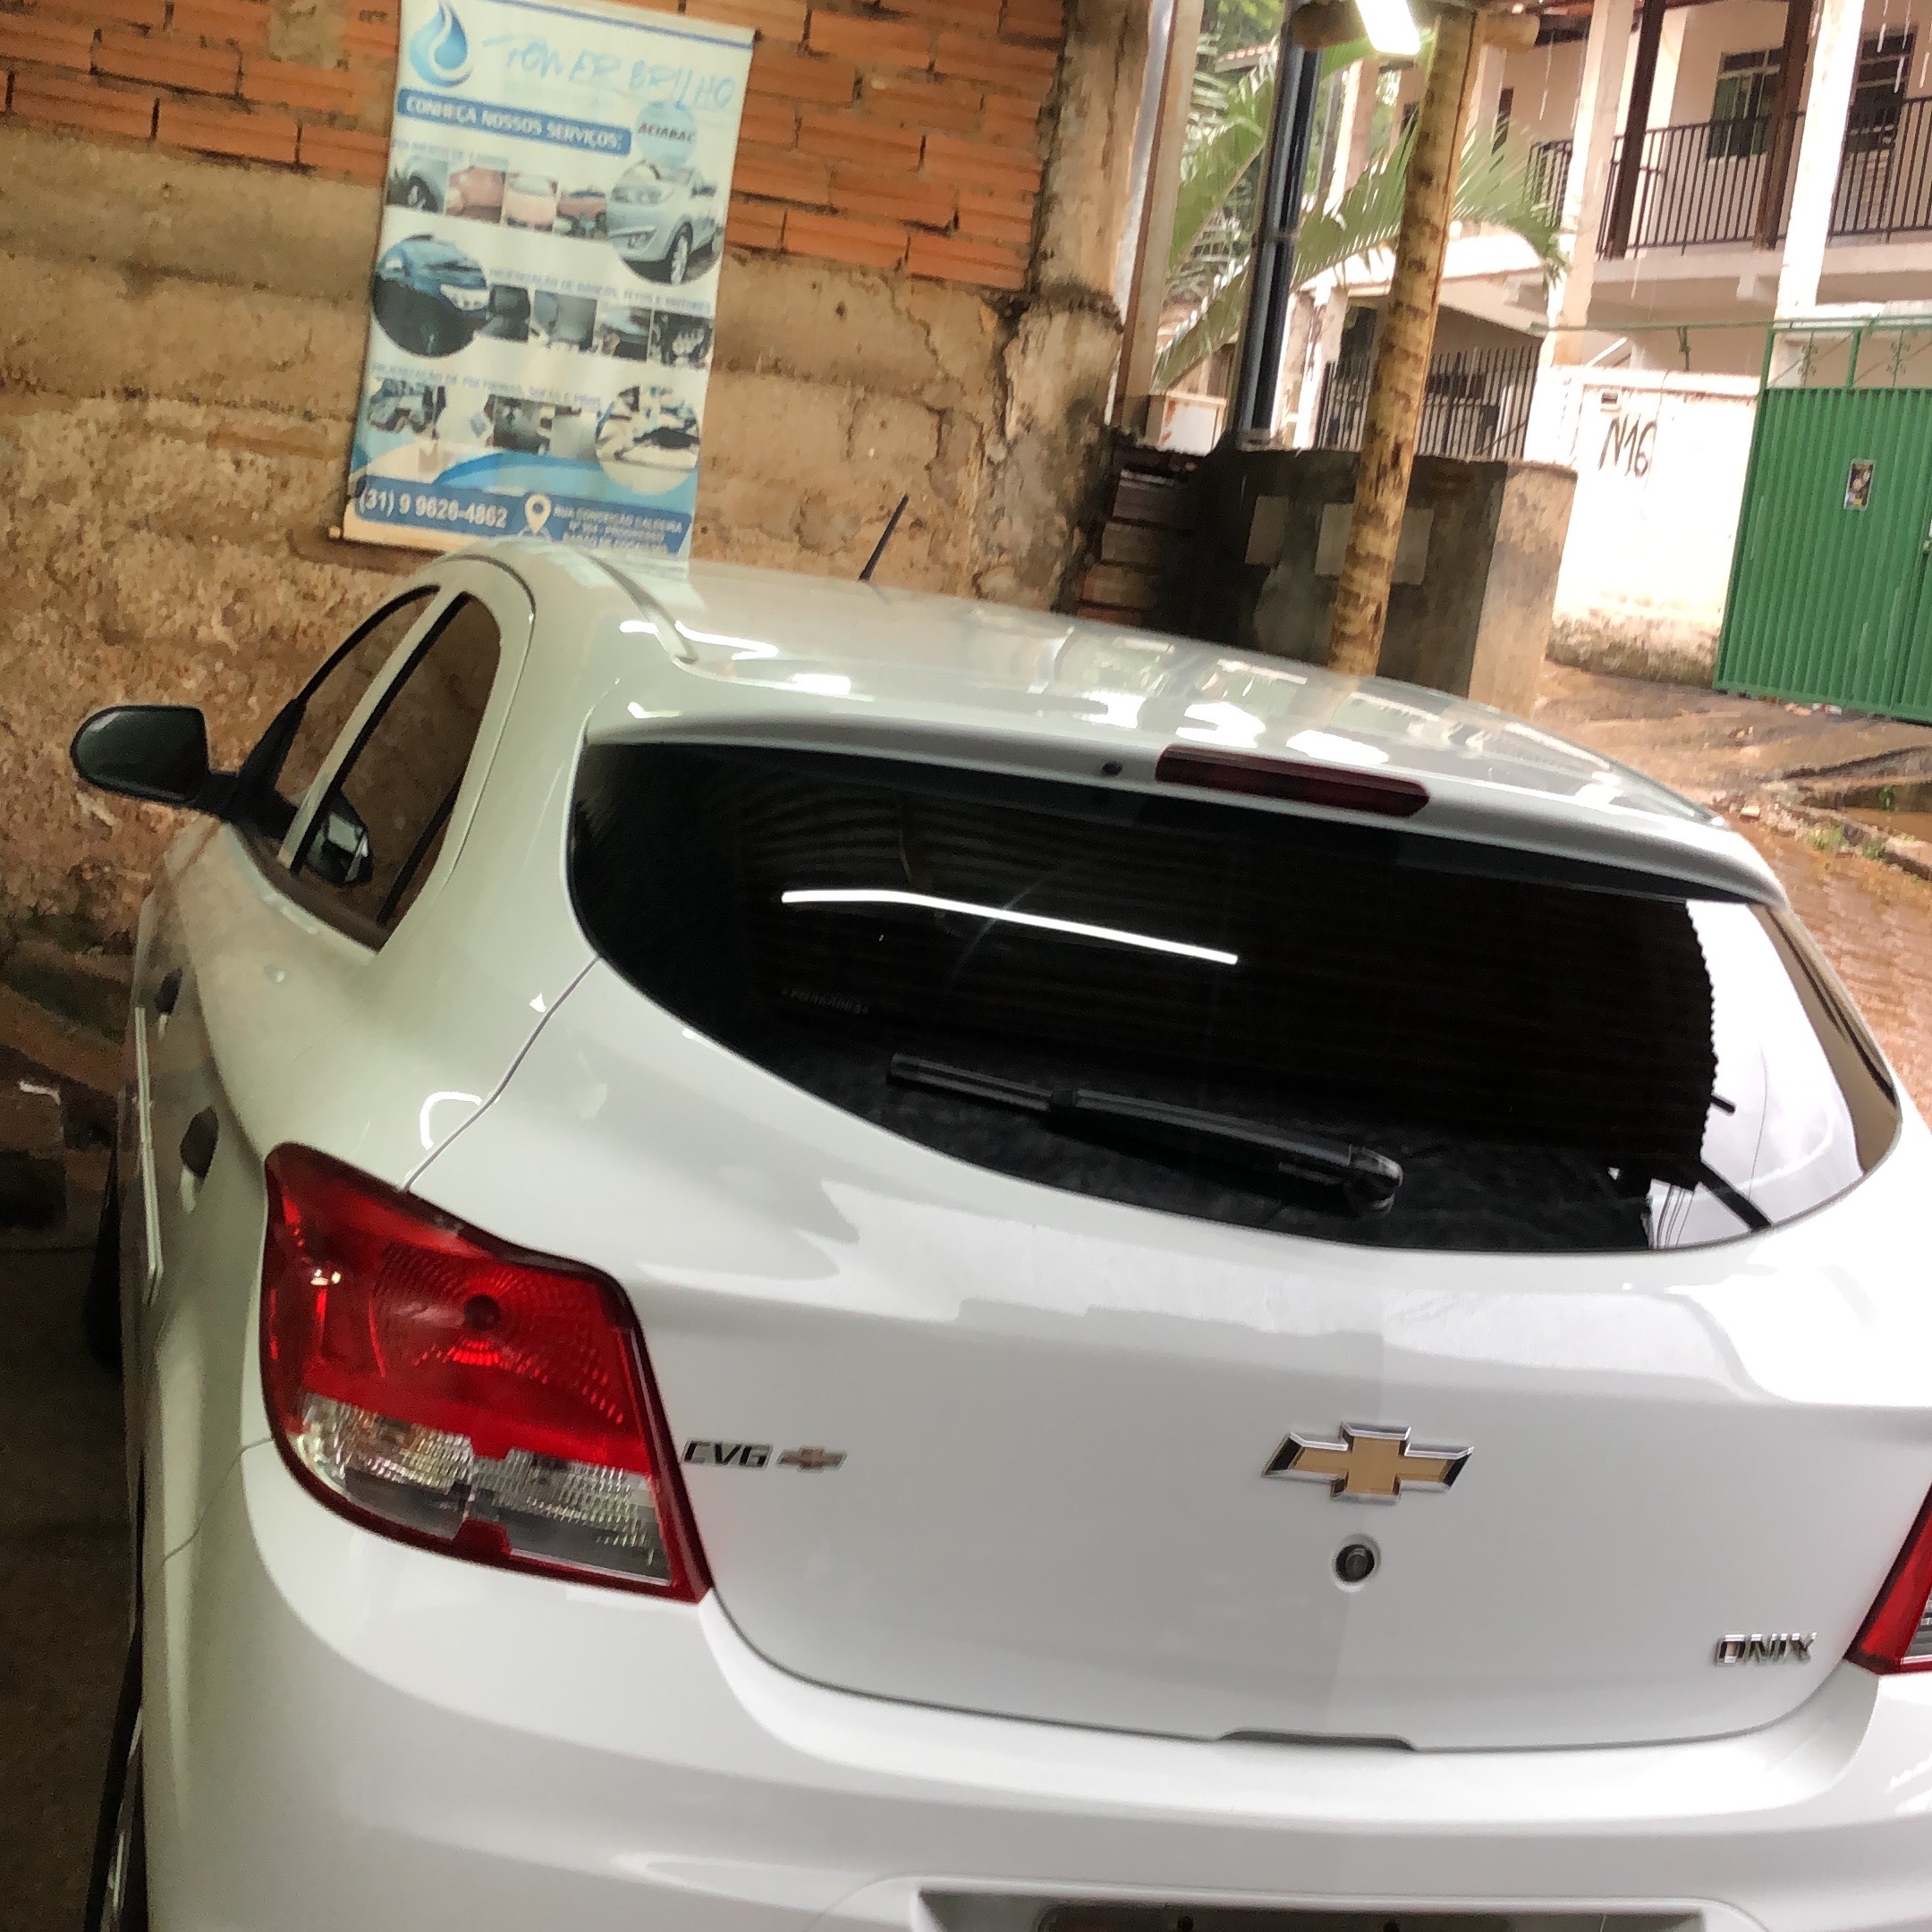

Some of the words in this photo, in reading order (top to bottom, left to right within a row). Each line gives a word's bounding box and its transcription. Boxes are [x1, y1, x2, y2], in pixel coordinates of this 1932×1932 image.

[405, 96, 477, 123] CONHEÇA
[481, 109, 543, 136] NOSSOS
[360, 487, 394, 518] (31)
[399, 493, 411, 515] 9
[1715, 1632, 1817, 1665] ONIX
